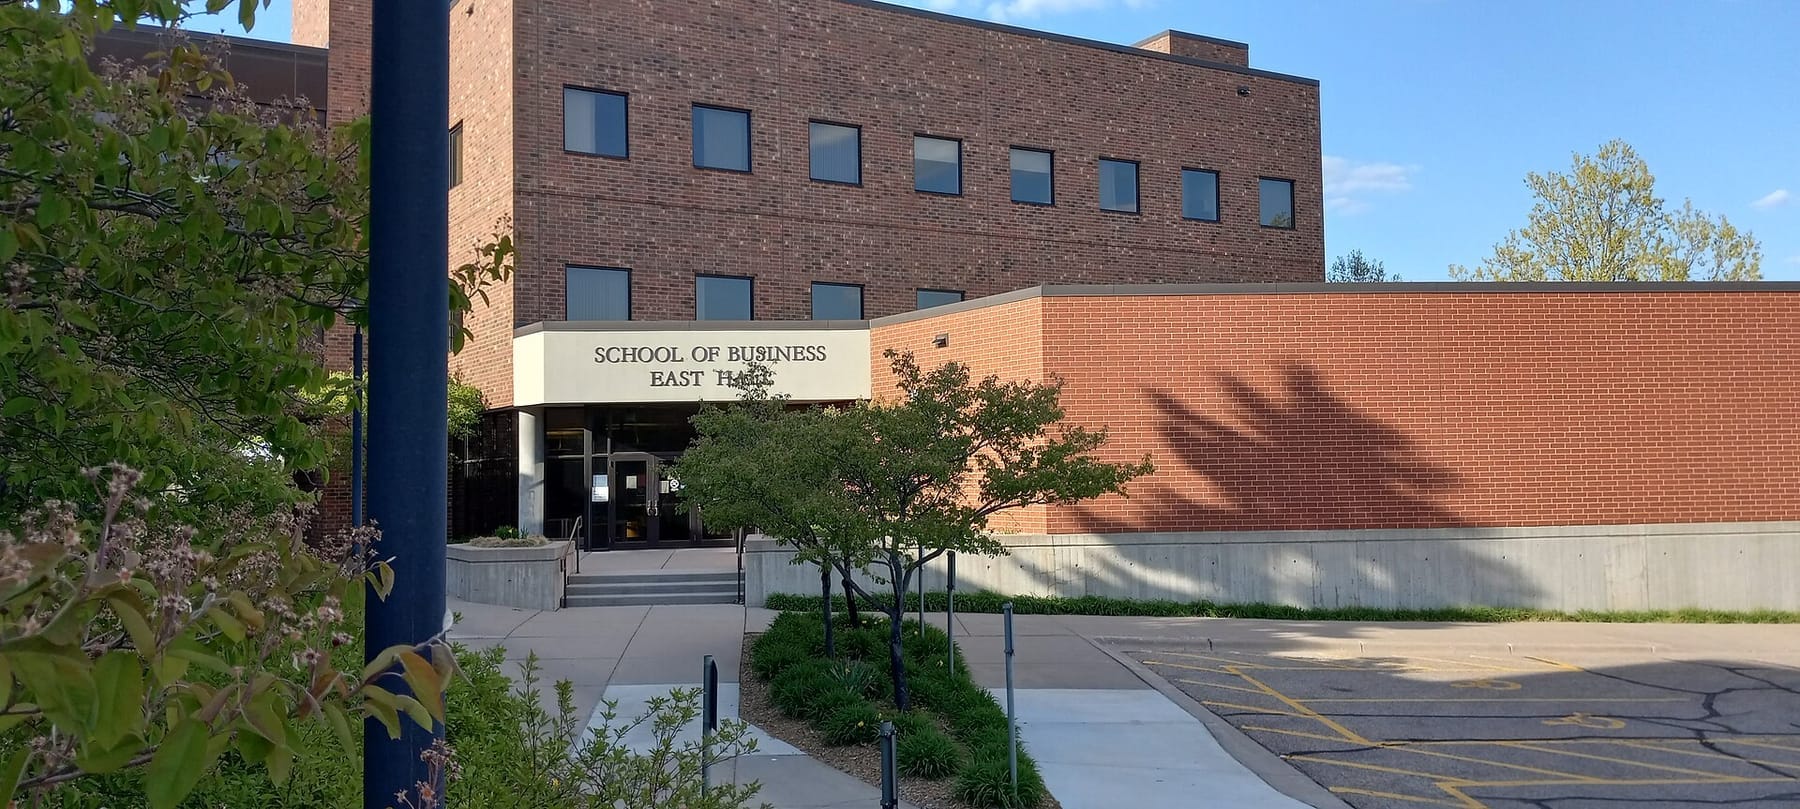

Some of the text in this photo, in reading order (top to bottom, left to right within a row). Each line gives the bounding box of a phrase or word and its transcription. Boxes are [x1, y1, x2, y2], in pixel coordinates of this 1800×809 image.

[594, 345, 827, 363] SCHOOL OF BUSINESS
[650, 371, 704, 387] EAST
